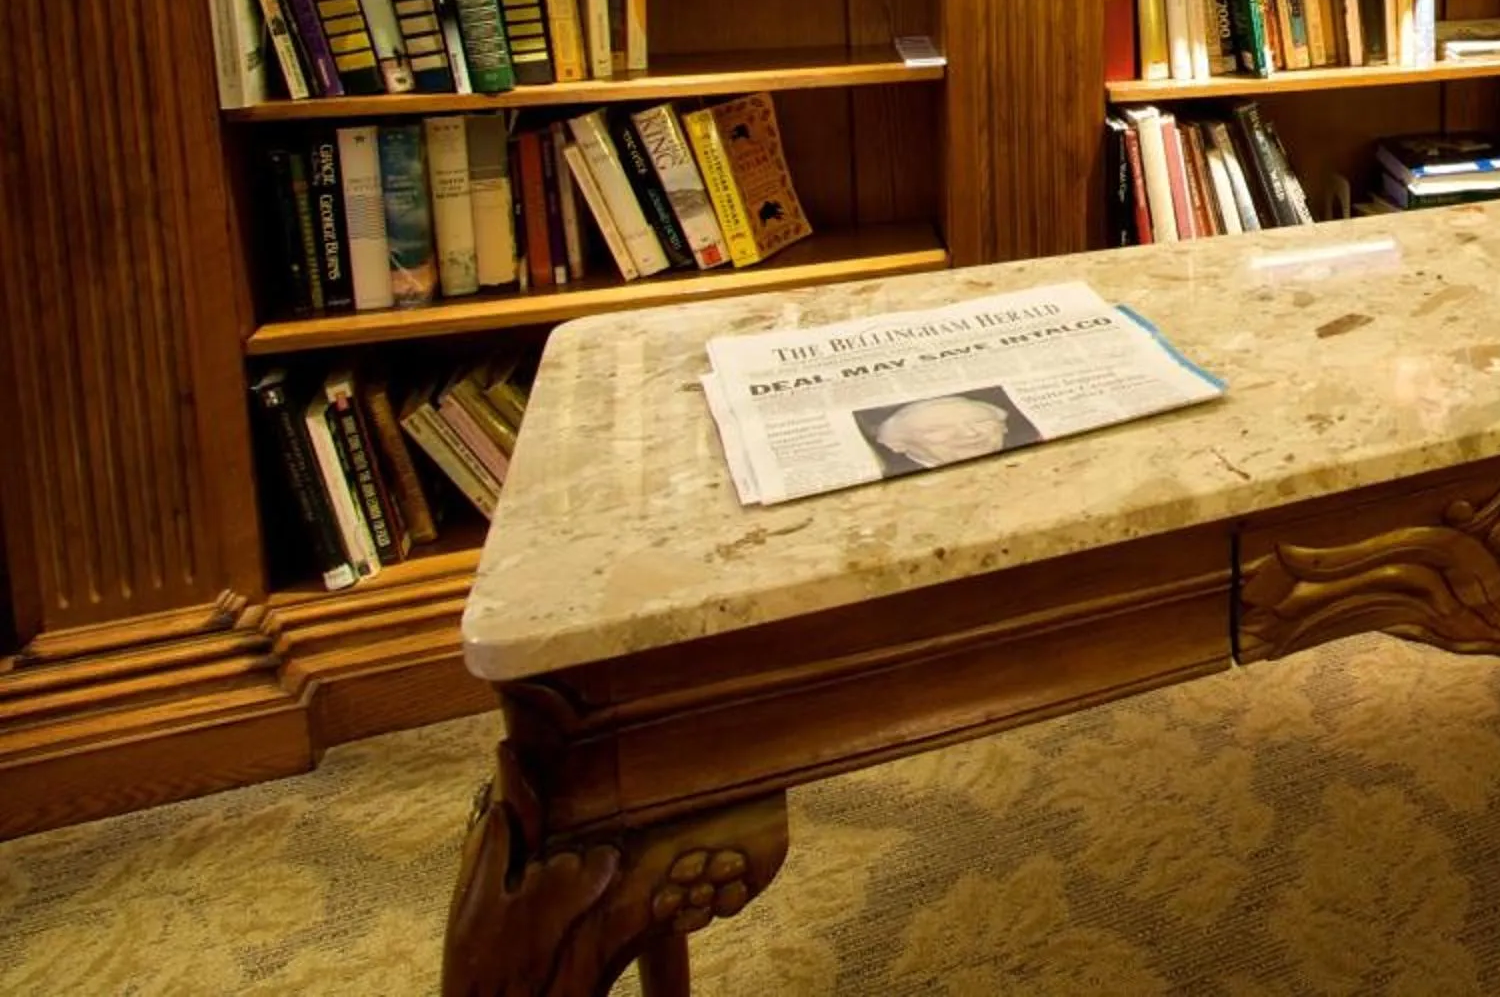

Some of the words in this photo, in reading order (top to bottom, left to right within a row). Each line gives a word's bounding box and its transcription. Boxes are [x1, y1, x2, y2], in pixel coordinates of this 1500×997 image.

[639, 112, 674, 171] KING
[749, 374, 827, 397] DEAL
[840, 358, 907, 380] MAY
[917, 343, 991, 362] SAVE
[999, 315, 1113, 347] INTALCO
[772, 344, 820, 363] THE
[829, 319, 972, 353] BELLINGHAM
[975, 303, 1062, 329] HERALD
